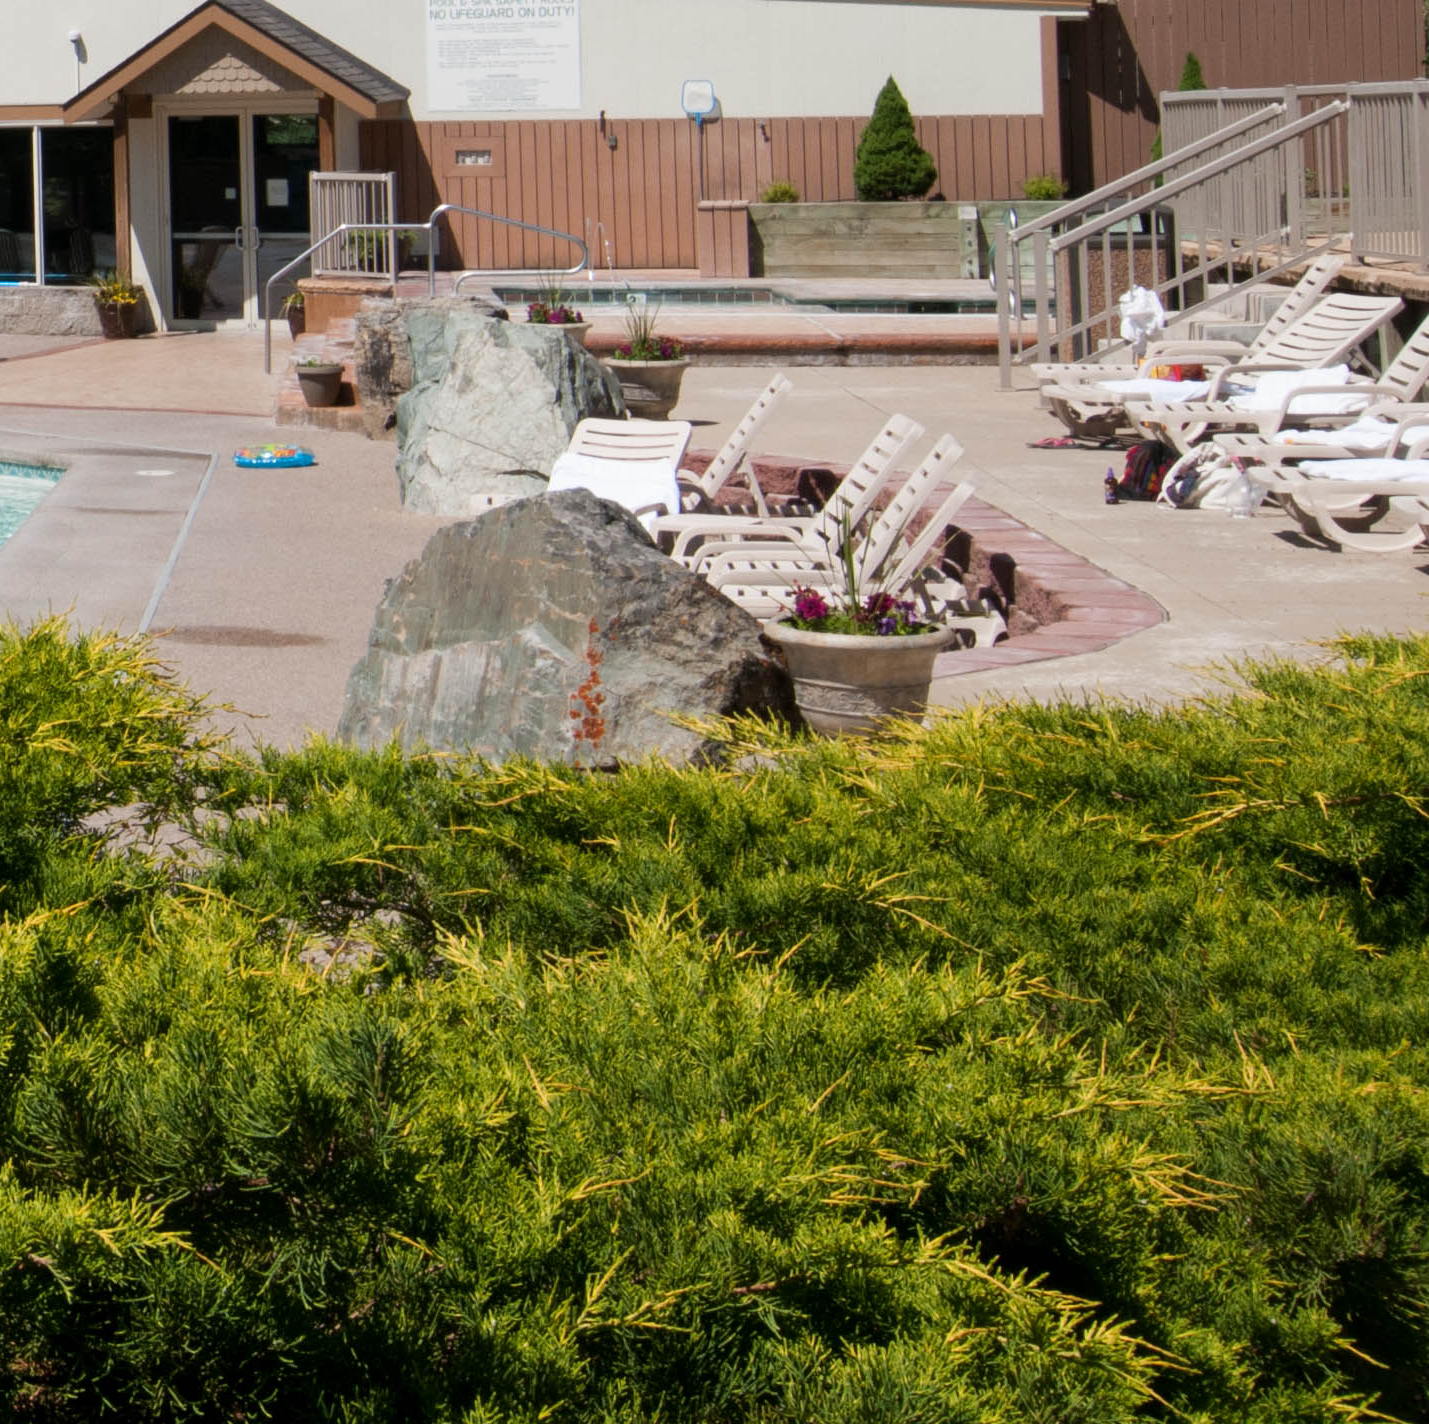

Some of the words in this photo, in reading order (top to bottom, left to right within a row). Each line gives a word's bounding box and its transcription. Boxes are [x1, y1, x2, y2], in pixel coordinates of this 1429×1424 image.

[429, 9, 446, 20] NO
[449, 7, 514, 19] LIFEGUARD
[518, 6, 535, 17] ON
[538, 6, 574, 17] DUTY!
